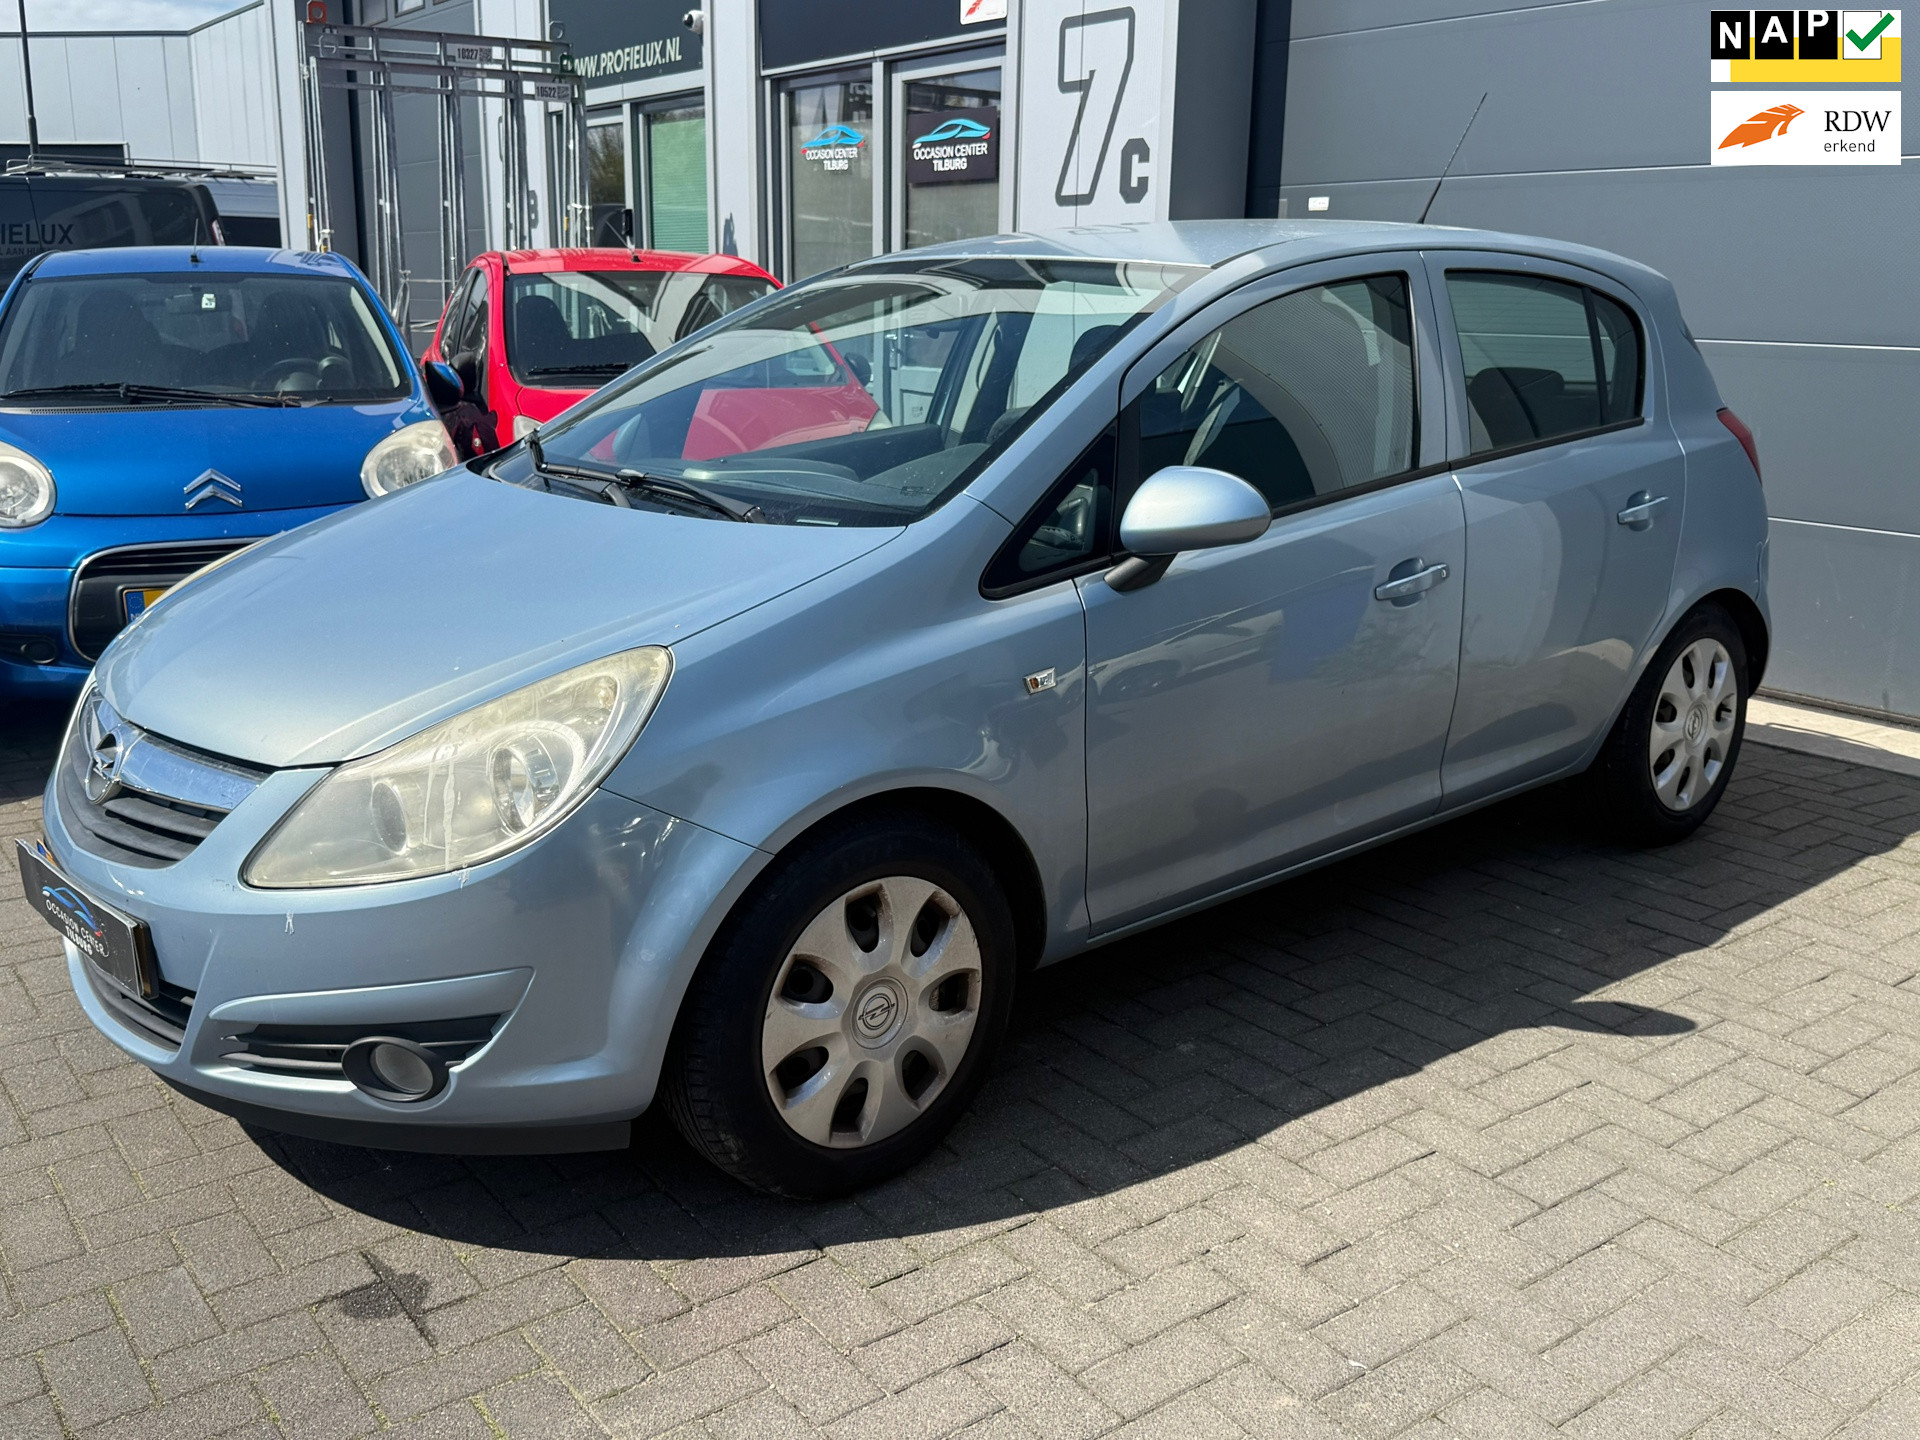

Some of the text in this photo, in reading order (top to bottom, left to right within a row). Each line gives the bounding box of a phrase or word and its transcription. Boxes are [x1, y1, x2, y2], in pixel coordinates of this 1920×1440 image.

[457, 47, 479, 60] 10327
[535, 85, 557, 99] 10522
[805, 147, 859, 161] OCCASION CENTER
[913, 143, 988, 161] OCCASION CENTER
[823, 159, 849, 171] TILBURG
[932, 158, 968, 172] TILBURG
[46, 899, 107, 958] OCCASION CENTER
